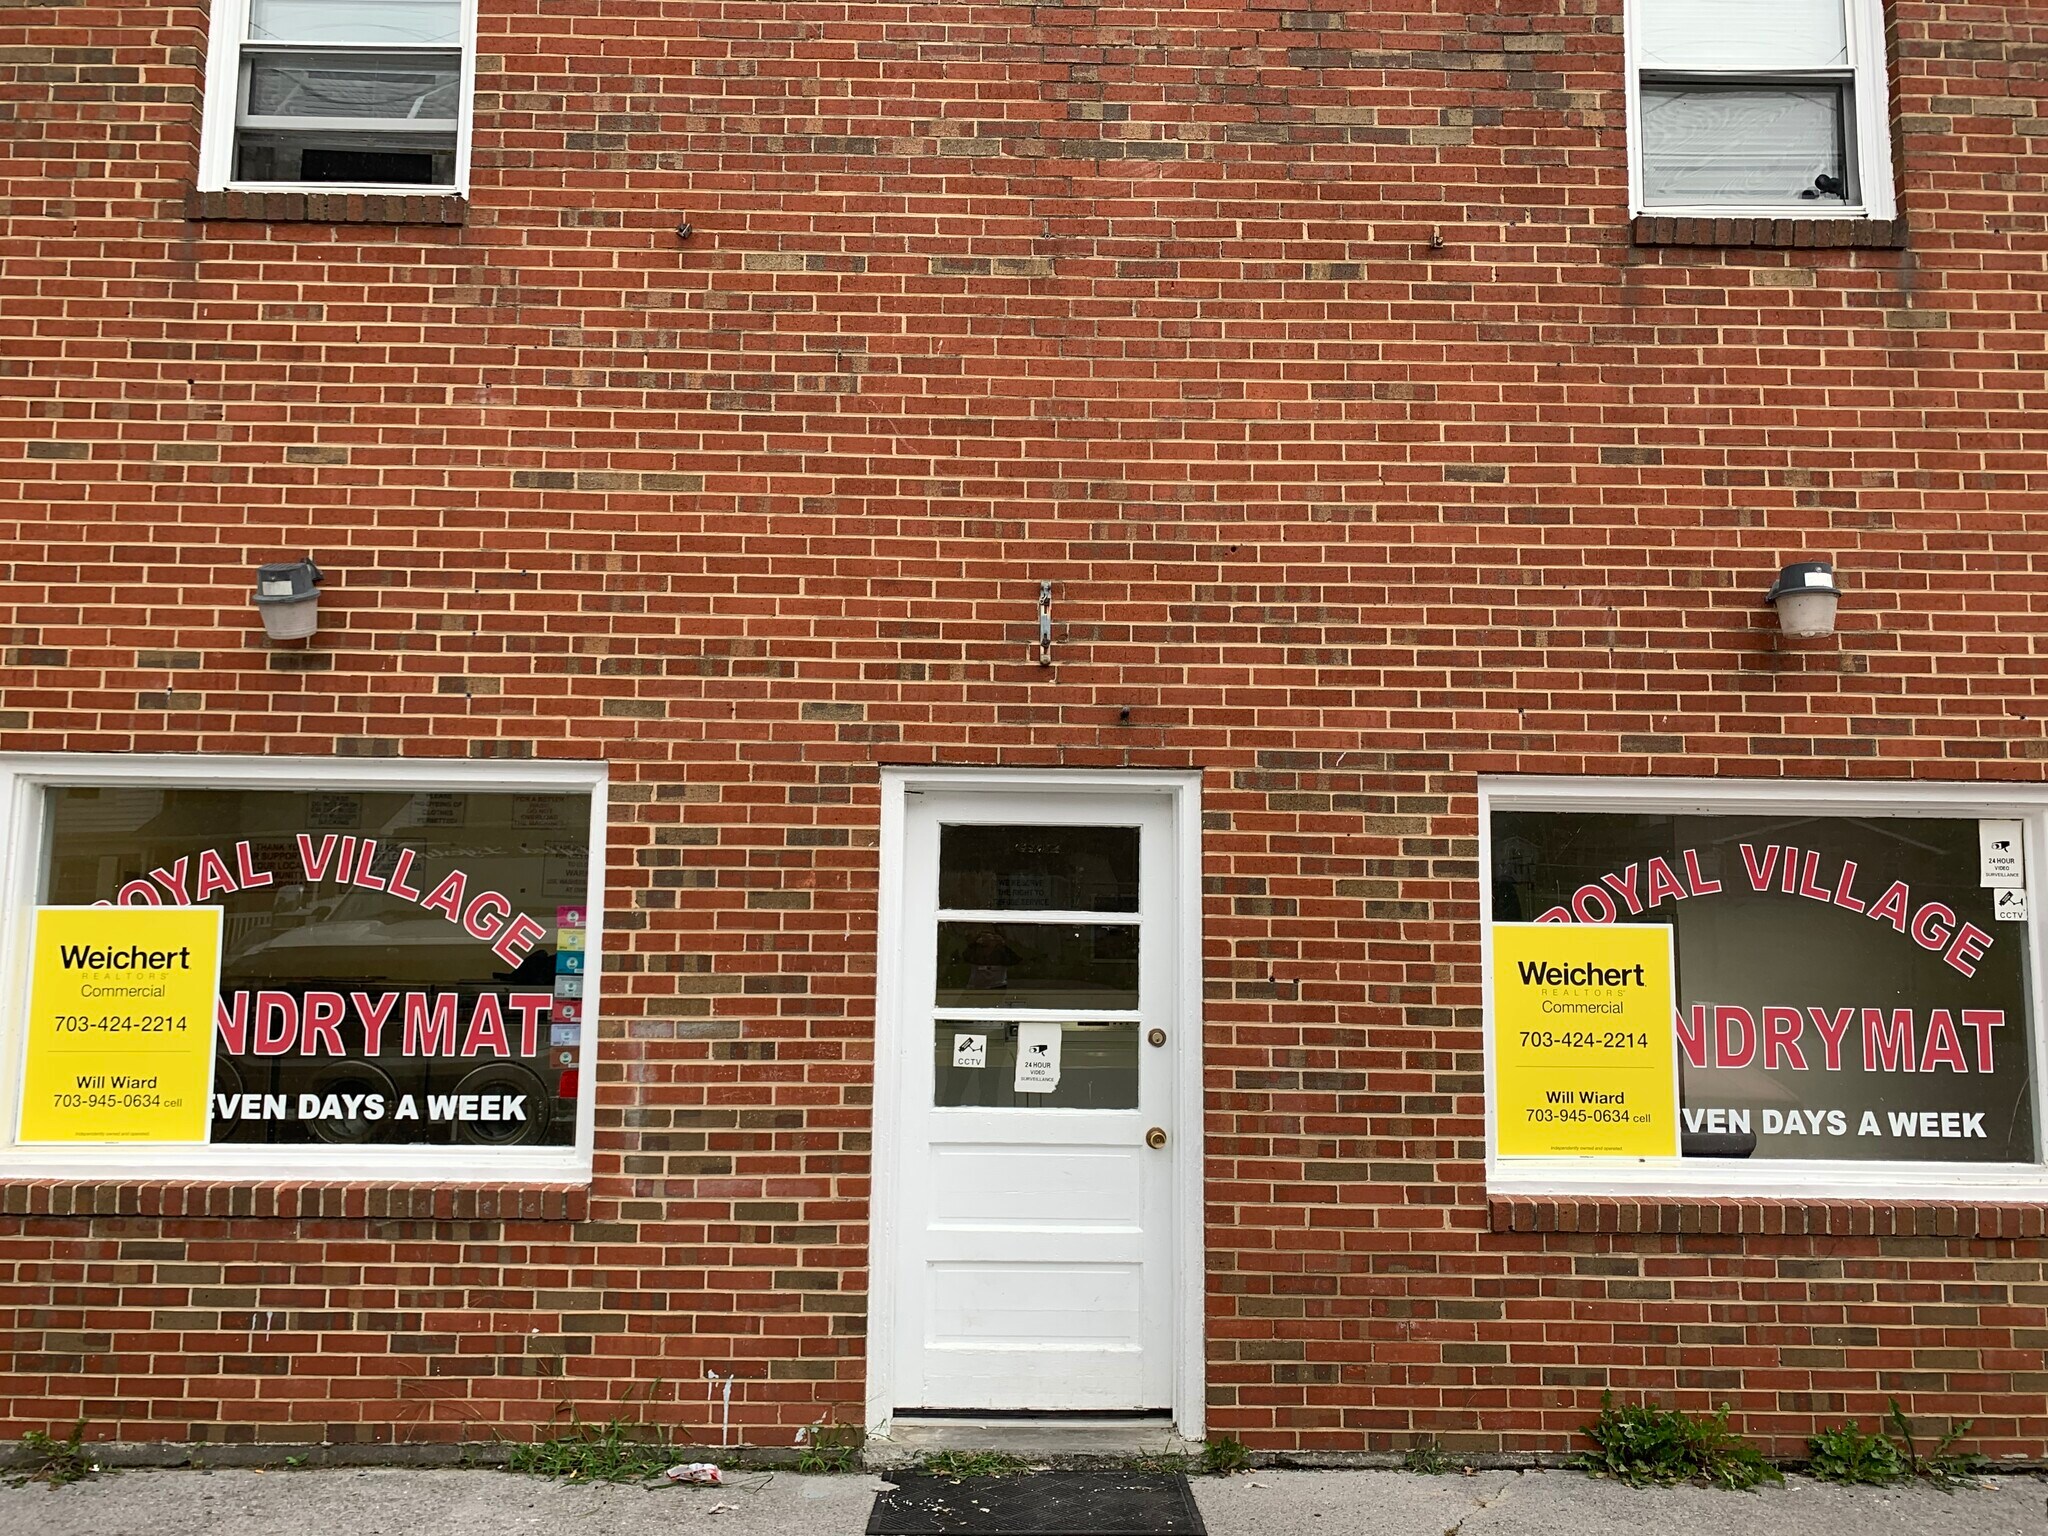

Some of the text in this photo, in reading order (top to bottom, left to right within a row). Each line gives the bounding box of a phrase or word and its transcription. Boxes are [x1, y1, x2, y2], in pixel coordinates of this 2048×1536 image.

[262, 852, 299, 861] SUPPOR
[278, 862, 303, 870] LOCA
[91, 833, 546, 968] OYAL VILLAGE
[1739, 843, 1994, 978] VILLAGE
[2000, 911, 2023, 919] CCTV
[60, 945, 191, 970] Weichert
[1517, 961, 1646, 987] Weichert
[81, 984, 166, 998] Commercial
[1542, 1000, 1625, 1014] Commercial
[55, 1016, 188, 1032] 703-424-2214
[1519, 1031, 1649, 1049] 703-424-2214
[958, 1058, 982, 1066] CCTV
[77, 1076, 158, 1089] Will Wiard
[54, 1094, 183, 1107] 703-945-0634 cell
[1546, 1091, 1625, 1105] Will Wiard
[298, 1094, 383, 1120] DAYS
[394, 1095, 418, 1120] A
[426, 1095, 527, 1121] WEEK
[1526, 1109, 1652, 1123] 703-945-0634 cell
[1762, 1109, 1847, 1136] DAYS
[1858, 1110, 1881, 1136] A
[1888, 1112, 1987, 1138] WEEK
